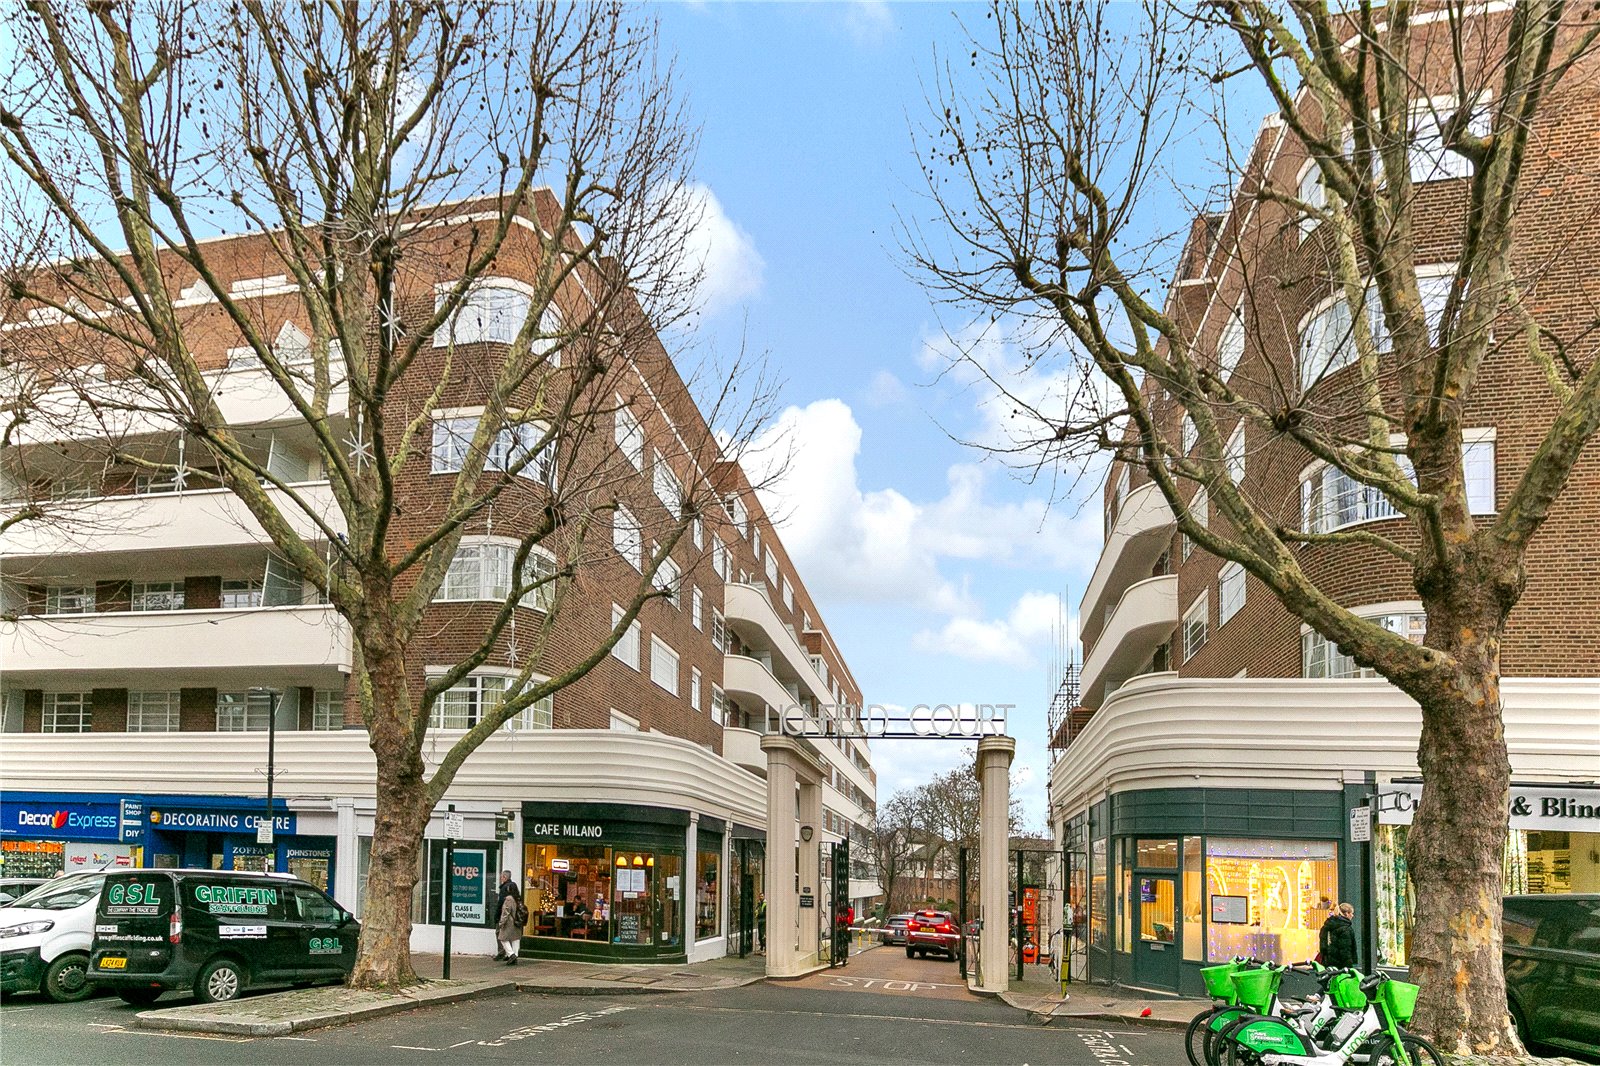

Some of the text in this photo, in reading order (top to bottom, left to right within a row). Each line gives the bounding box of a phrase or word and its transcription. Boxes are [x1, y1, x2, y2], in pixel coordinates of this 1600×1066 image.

[765, 703, 1016, 737] LICHFIELD COURT
[1511, 796, 1532, 816] &
[19, 811, 117, 829] Decor Express
[163, 812, 239, 828] DECORATING
[534, 824, 603, 837] CAFE MILANO
[109, 883, 161, 905] GSL
[195, 886, 278, 905] GRIFFIN
[209, 904, 268, 914] SCAFFOLDING
[455, 912, 481, 920] ENQUIRIES
[309, 938, 343, 950] GSL
[829, 978, 937, 991] STOP
[1341, 1030, 1367, 1057] Lime
